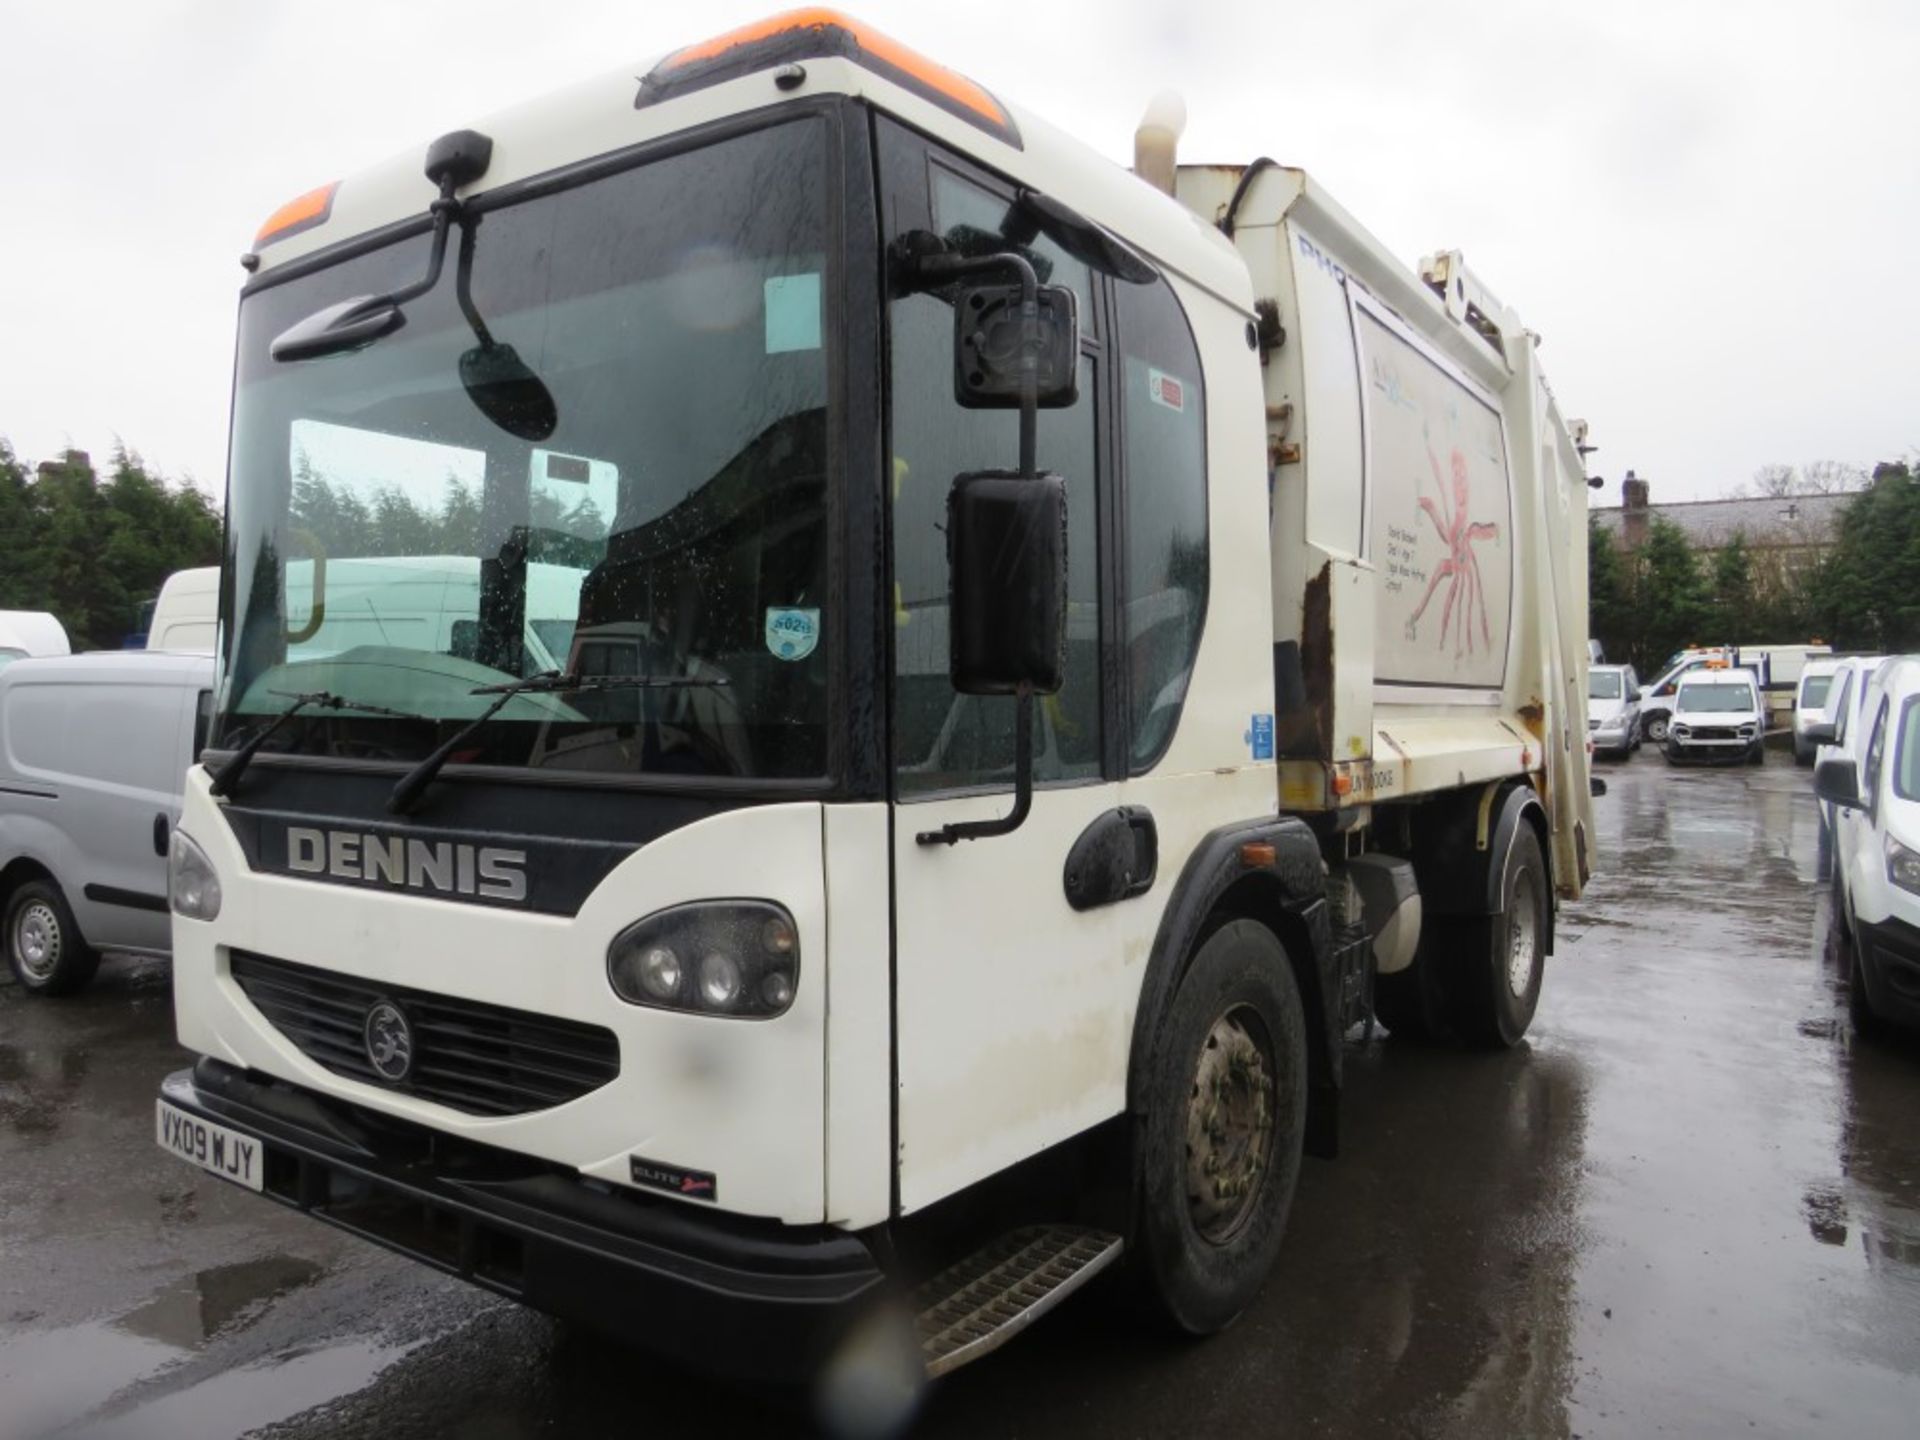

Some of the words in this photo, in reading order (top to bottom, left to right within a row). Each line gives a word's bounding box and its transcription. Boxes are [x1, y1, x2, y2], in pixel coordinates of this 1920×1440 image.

[286, 826, 528, 901] DENNIS
[161, 1108, 207, 1161] VX09
[212, 1131, 253, 1180] WJY
[633, 1165, 681, 1185] ELITE
